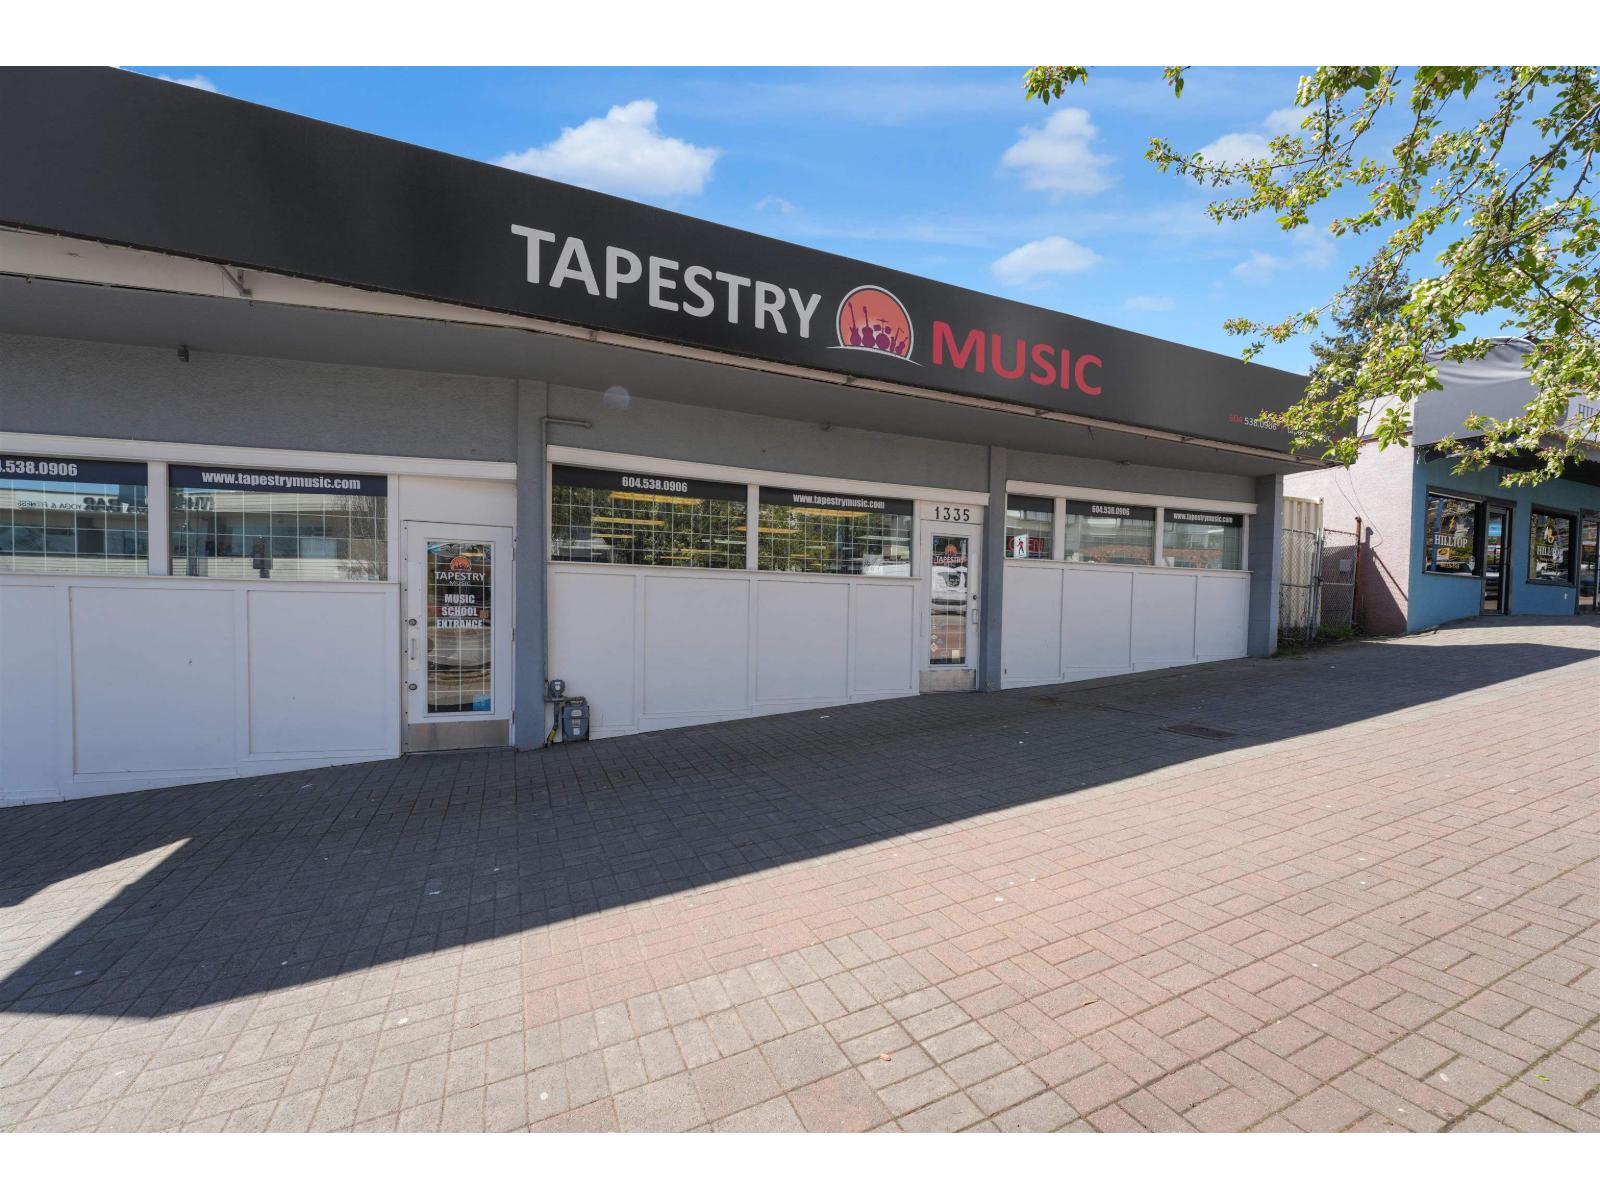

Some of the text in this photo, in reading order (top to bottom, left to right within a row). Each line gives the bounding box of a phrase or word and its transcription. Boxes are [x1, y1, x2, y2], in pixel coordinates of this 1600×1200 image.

[511, 224, 1103, 396] TAPESTRY MUSIC
[0, 459, 78, 477] .538.0906
[201, 470, 361, 491] www.tapestrymusic.com
[621, 475, 688, 494] 604.538.0906
[792, 492, 885, 510] www.tapestrymusic.com
[934, 506, 971, 522] 1335
[1091, 504, 1130, 516] 604.538.0906
[1434, 534, 1468, 549] HILLTOP
[434, 571, 486, 582] TAPESTRY
[444, 593, 476, 604] MUSIC
[441, 606, 479, 617] SCHOOL
[436, 619, 483, 630] ENTRANCE
